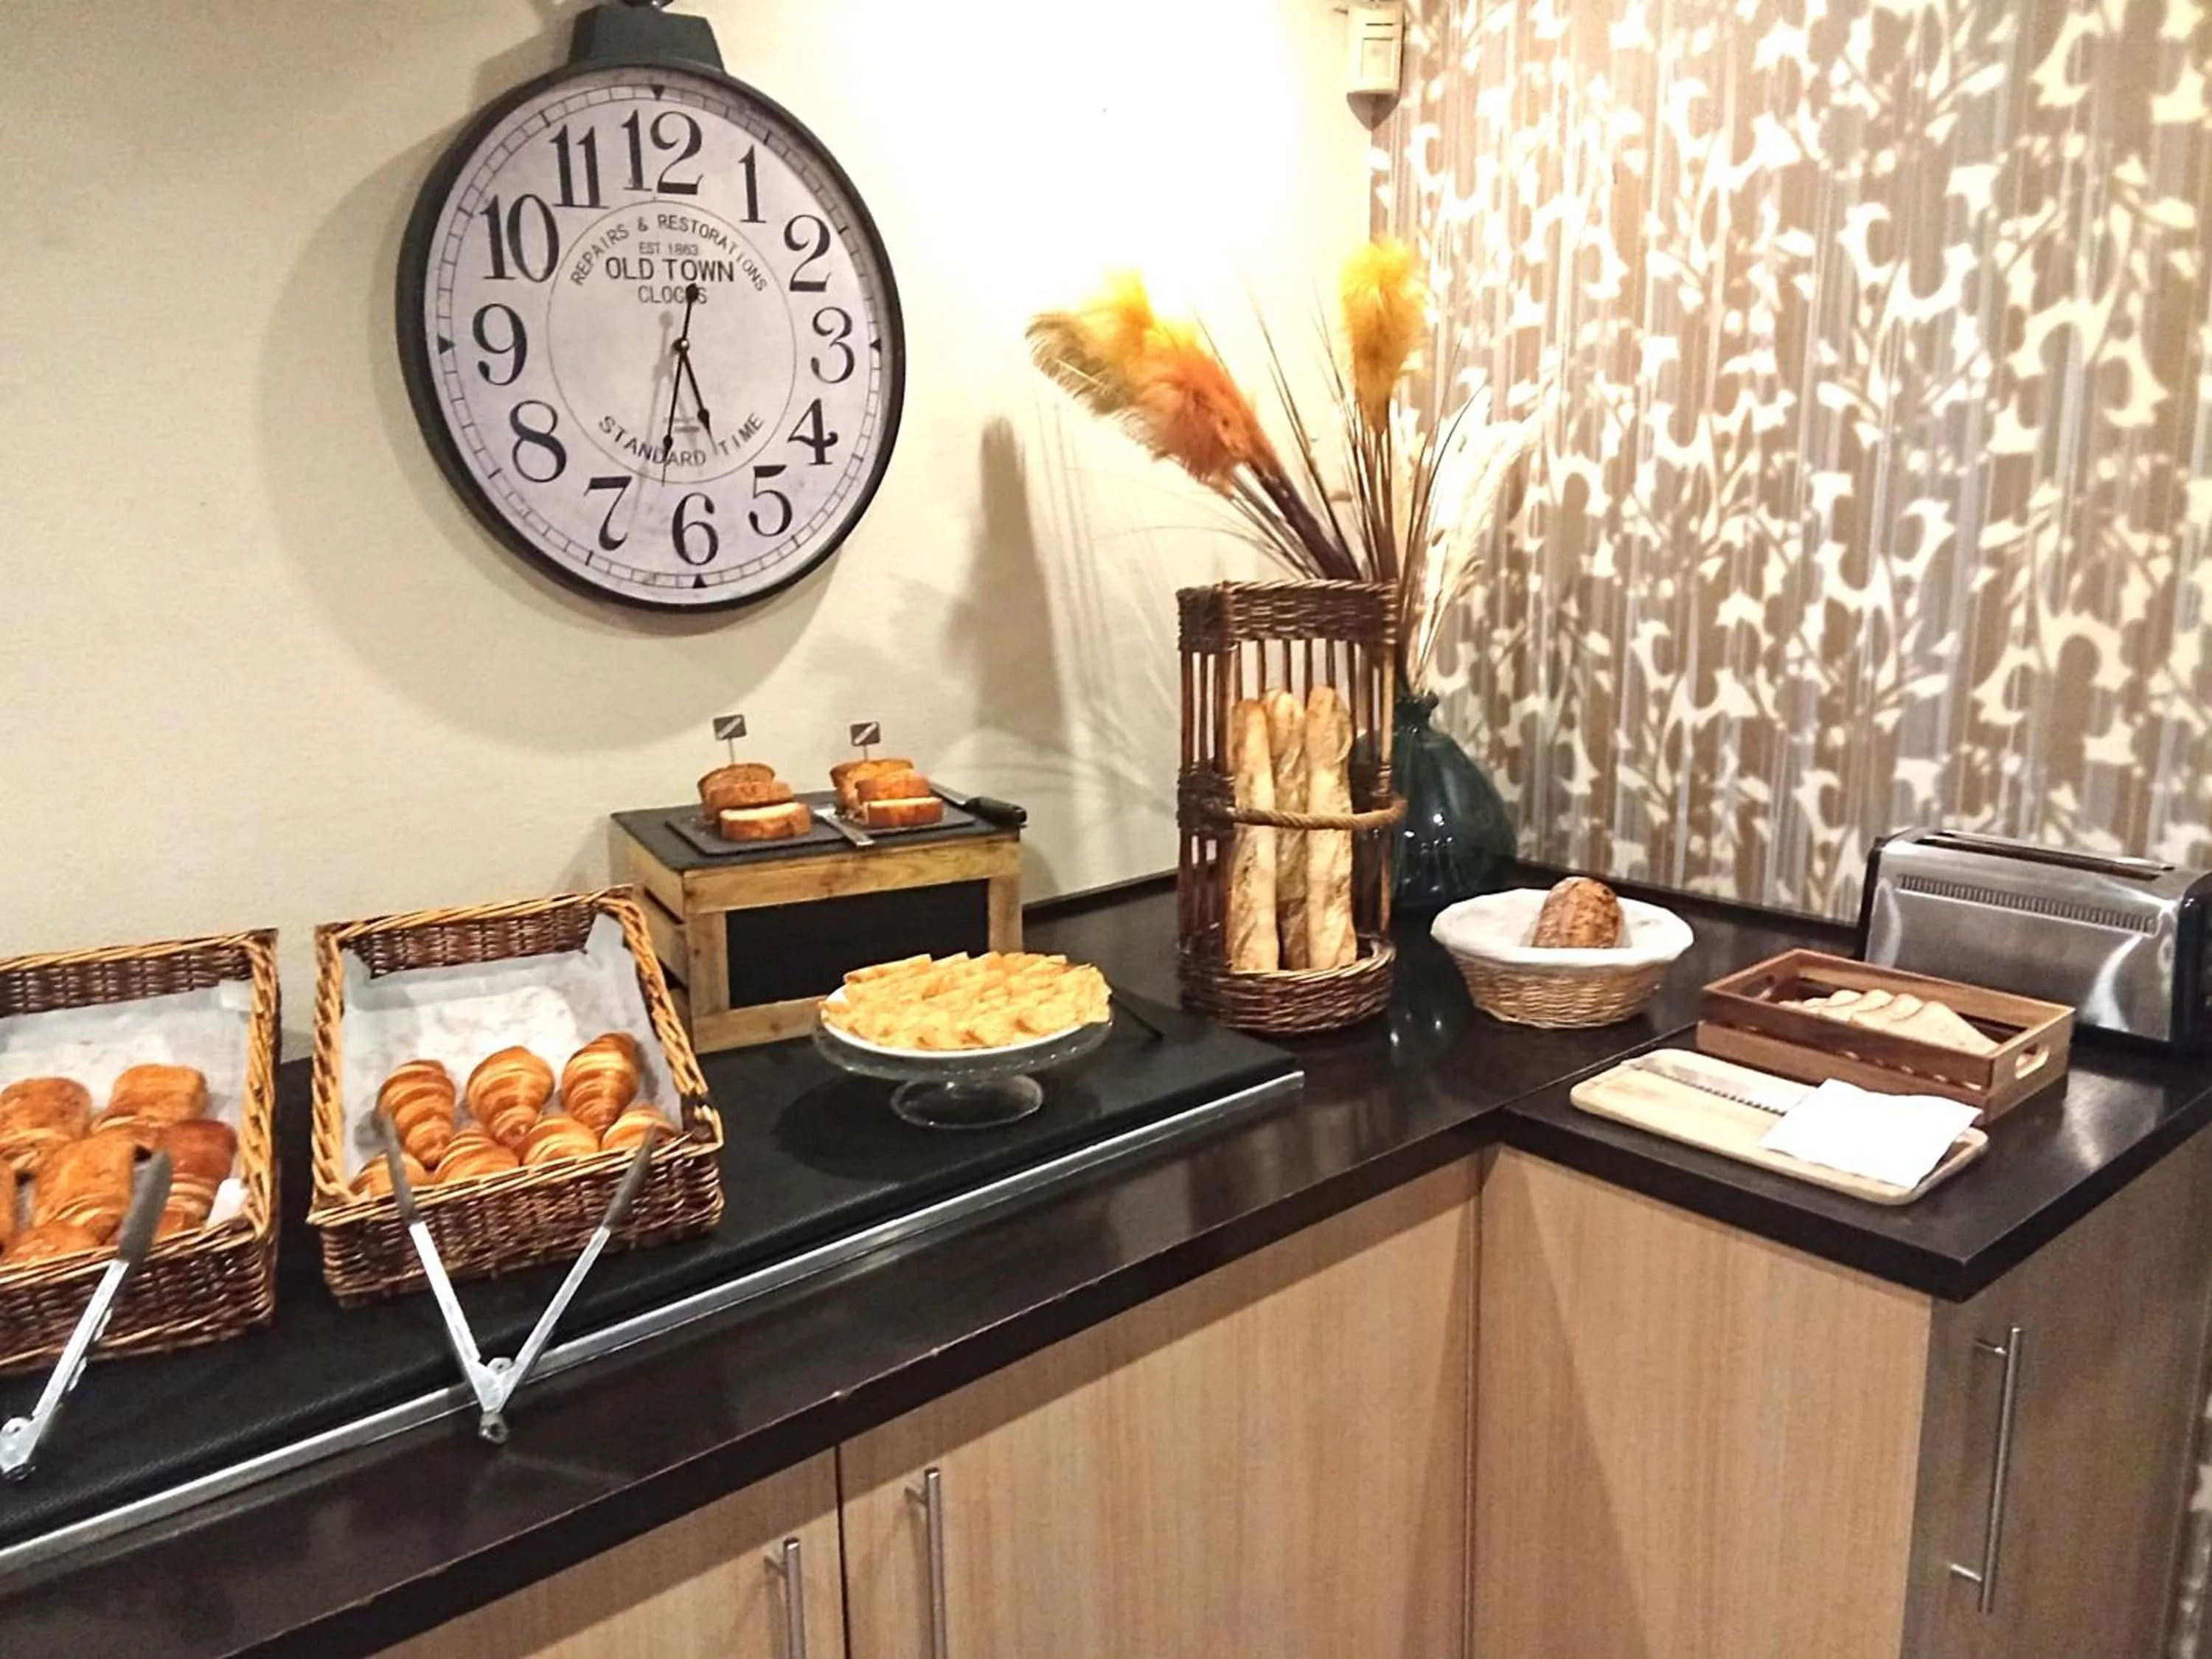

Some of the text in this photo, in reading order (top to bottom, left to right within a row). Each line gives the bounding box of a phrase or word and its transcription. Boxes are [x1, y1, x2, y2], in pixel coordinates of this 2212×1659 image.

[548, 124, 611, 209] 11
[621, 108, 704, 195] 12
[738, 145, 767, 223] 1
[479, 193, 560, 282] 10
[570, 223, 630, 286] REPAIRS
[657, 214, 768, 292] RESTORATIONS
[605, 257, 734, 282] OLD TOWN
[639, 242, 661, 254] EST
[783, 215, 832, 293] 2
[638, 285, 708, 304] CLOCS
[473, 304, 527, 386] 9
[810, 307, 855, 383] 3
[509, 400, 567, 483] 8
[598, 413, 765, 467] STANDARD TIME
[787, 397, 838, 465] 4
[583, 476, 633, 551] 7
[672, 492, 719, 566] 6
[748, 465, 793, 537] 5
